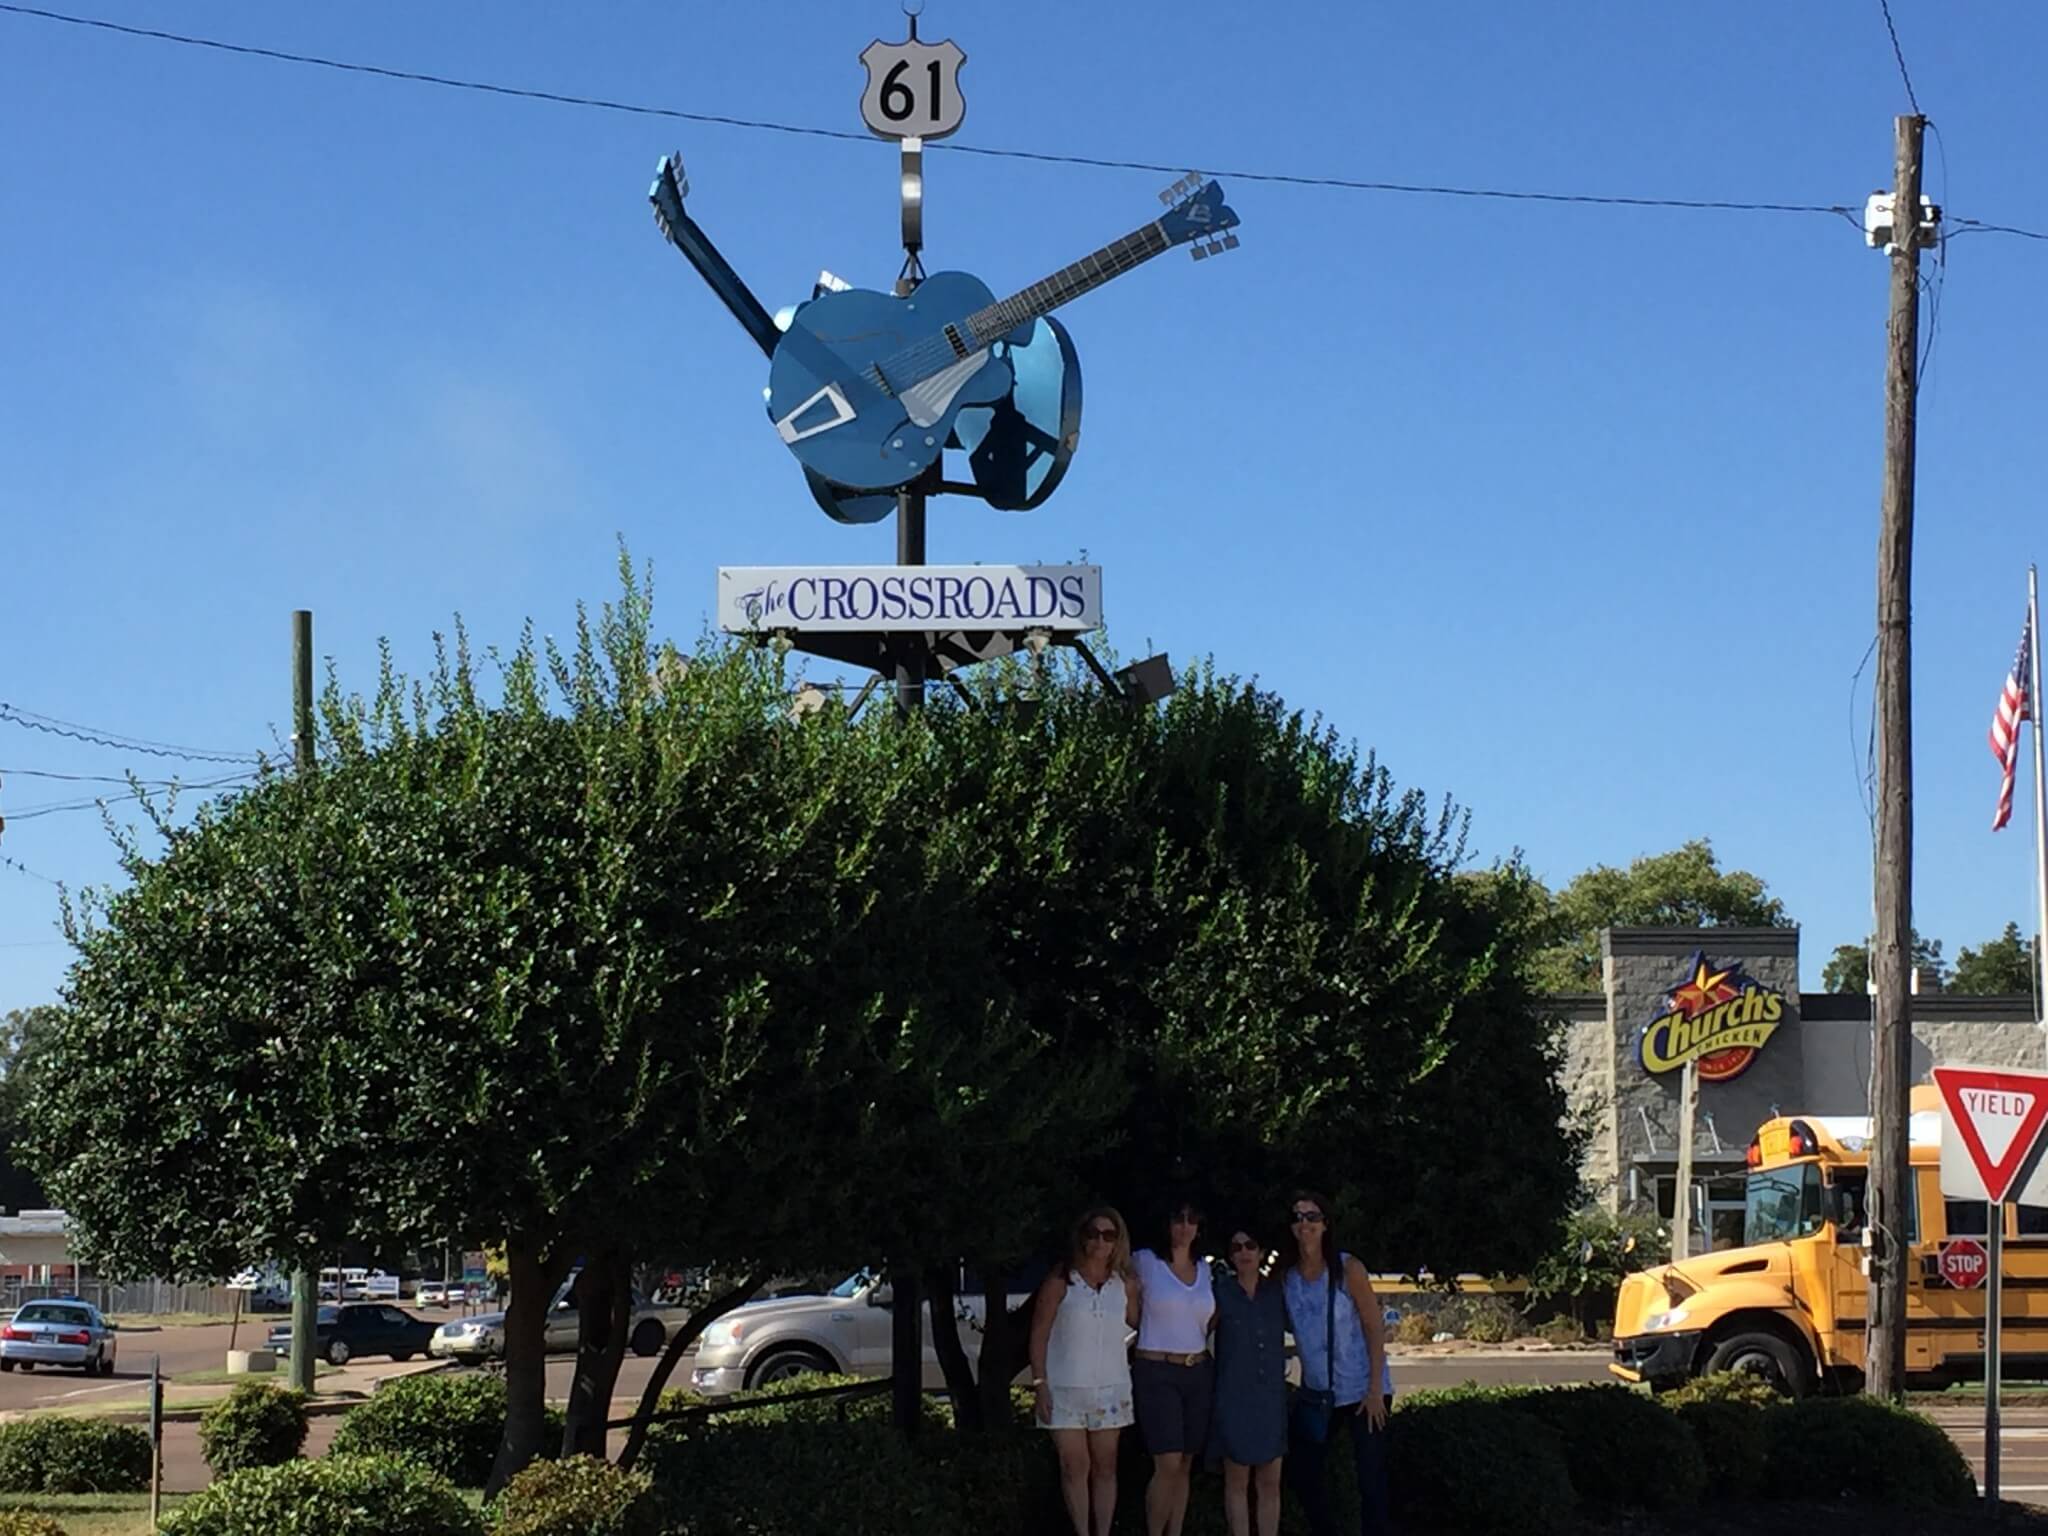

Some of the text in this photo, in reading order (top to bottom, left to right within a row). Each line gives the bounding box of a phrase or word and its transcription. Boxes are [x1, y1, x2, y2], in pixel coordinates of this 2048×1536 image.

[880, 60, 941, 121] 61
[735, 576, 1085, 621] The CROSSROADS
[1642, 986, 1782, 1073] Church's
[1696, 1029, 1762, 1053] CHICKEN
[1968, 1092, 2025, 1117] YIELD
[1947, 1255, 1983, 1273] STOP
